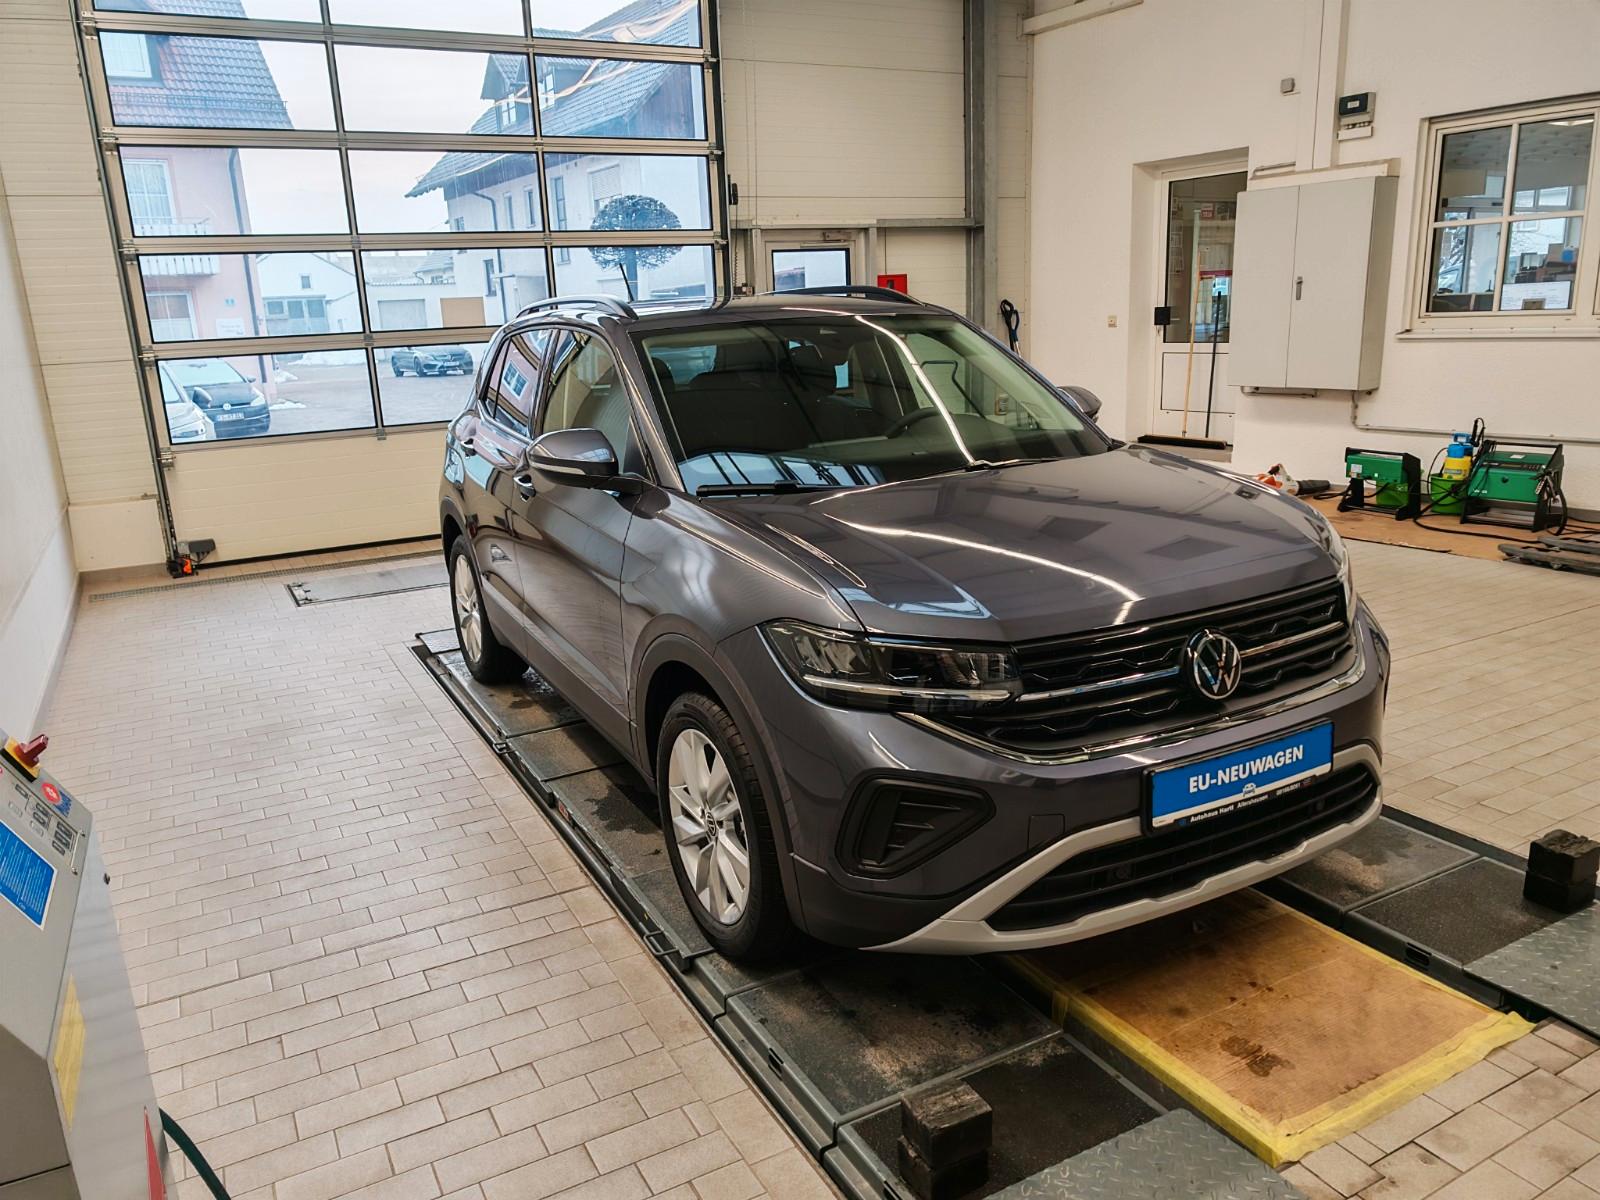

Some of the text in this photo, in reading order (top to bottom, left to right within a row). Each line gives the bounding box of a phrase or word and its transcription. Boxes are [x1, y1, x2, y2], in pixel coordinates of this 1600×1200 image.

[1194, 635, 1241, 698] VW
[1189, 745, 1304, 793] EU-NEUWAGEN
[1190, 809, 1218, 823] Autohaus
